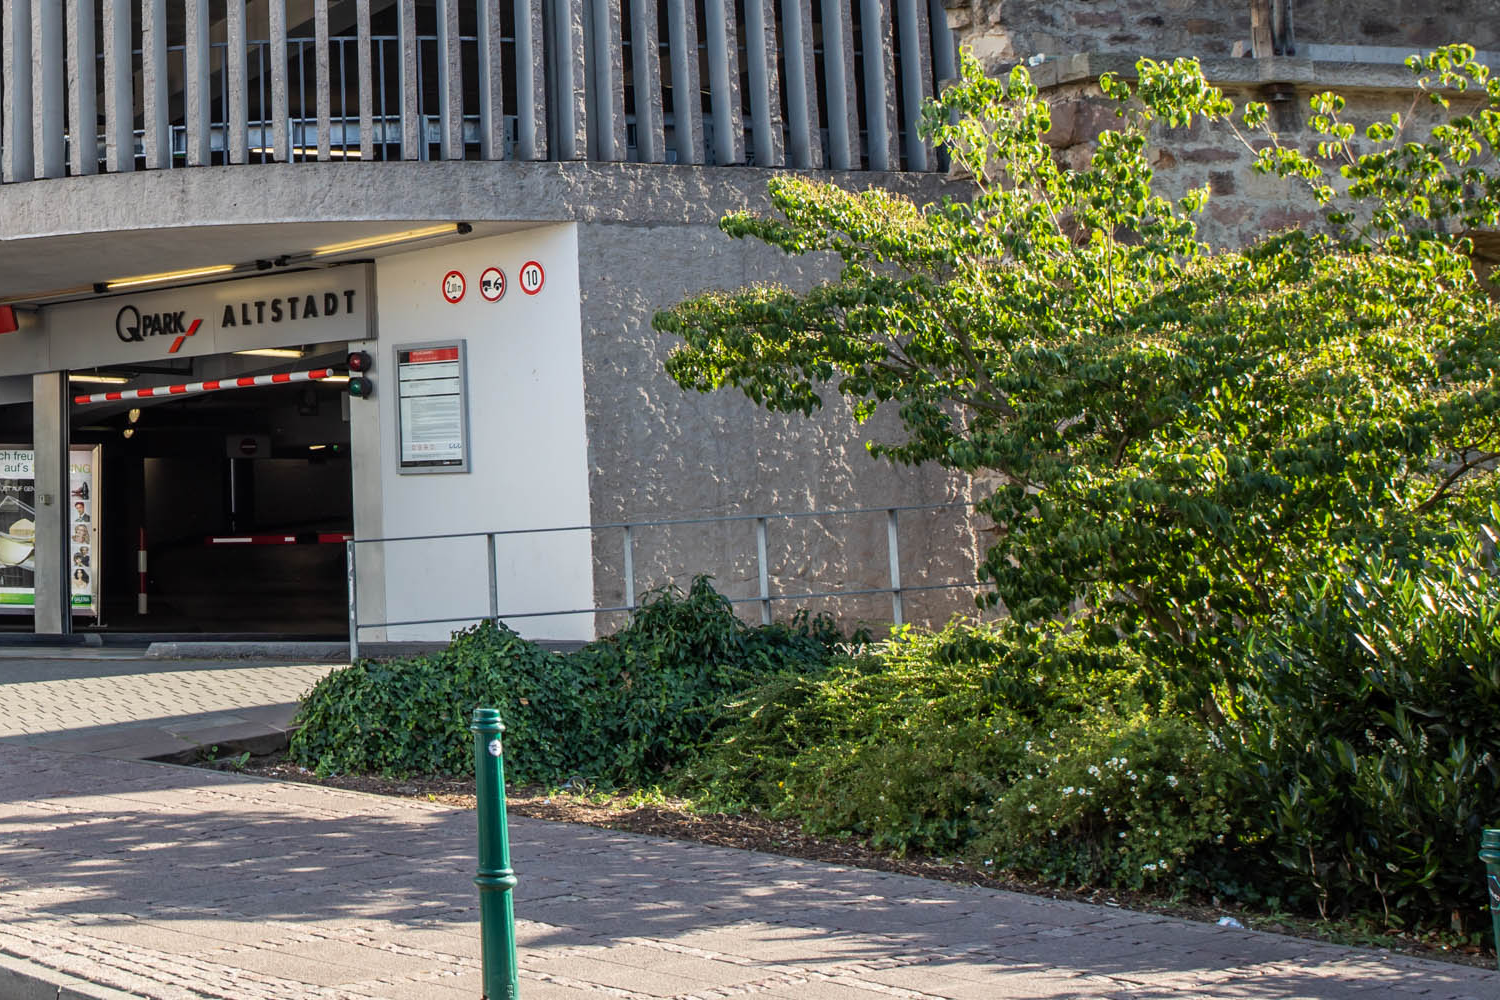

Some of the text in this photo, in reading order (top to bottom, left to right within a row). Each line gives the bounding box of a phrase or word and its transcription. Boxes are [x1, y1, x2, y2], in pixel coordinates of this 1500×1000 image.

[526, 269, 538, 287] 10
[221, 290, 357, 328] ALTSTADT
[14, 451, 33, 461] freu
